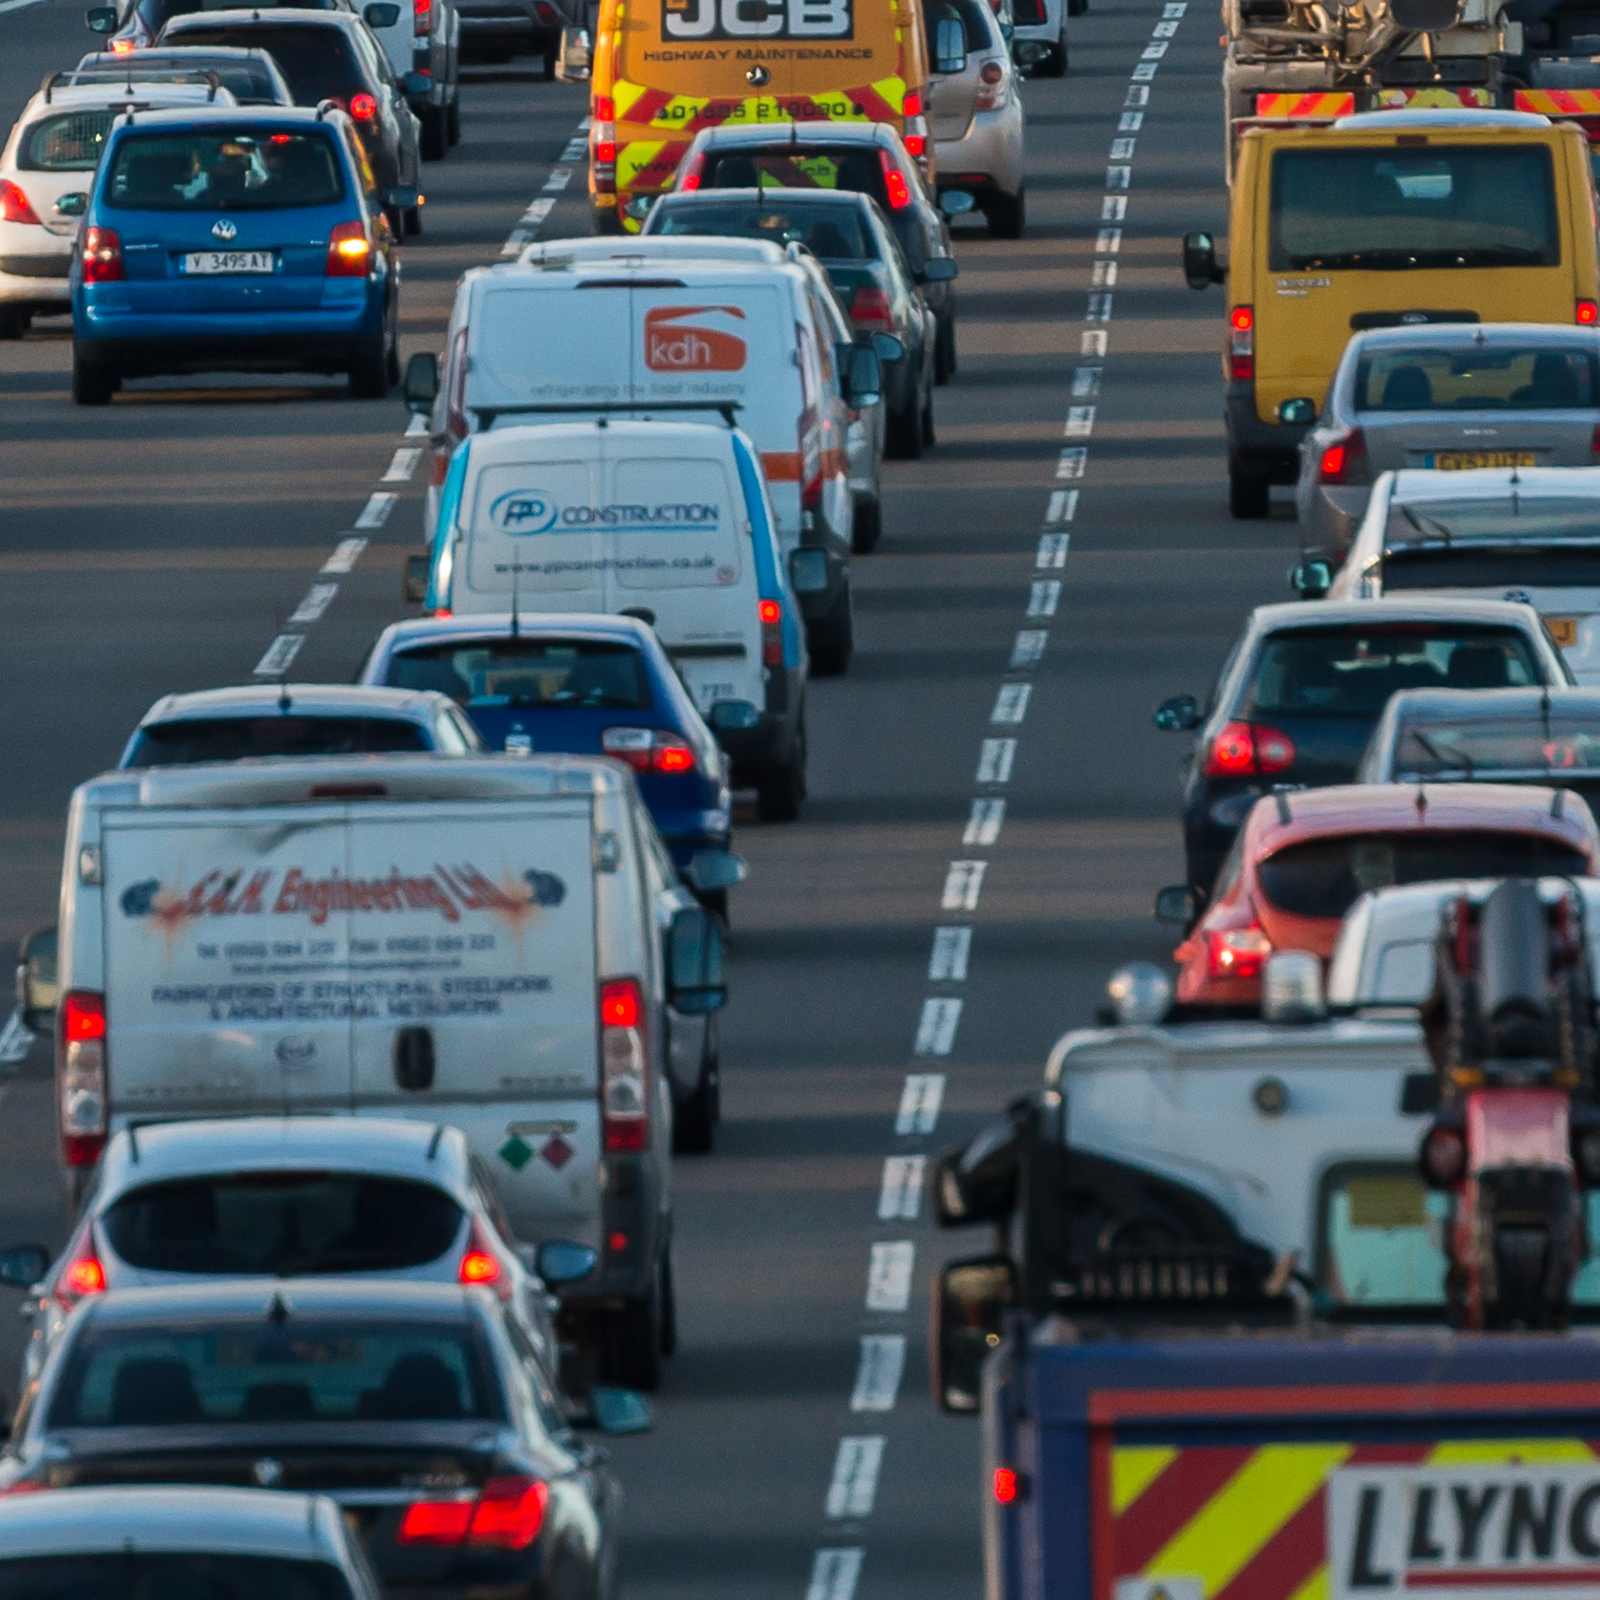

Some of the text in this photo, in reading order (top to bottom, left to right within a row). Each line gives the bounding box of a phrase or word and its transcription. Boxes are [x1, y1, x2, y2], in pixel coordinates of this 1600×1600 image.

[643, 48, 873, 63] HIGHWAY MAINTENANCE
[649, 334, 711, 367] kdh
[562, 503, 719, 526] CONSTRUCTION
